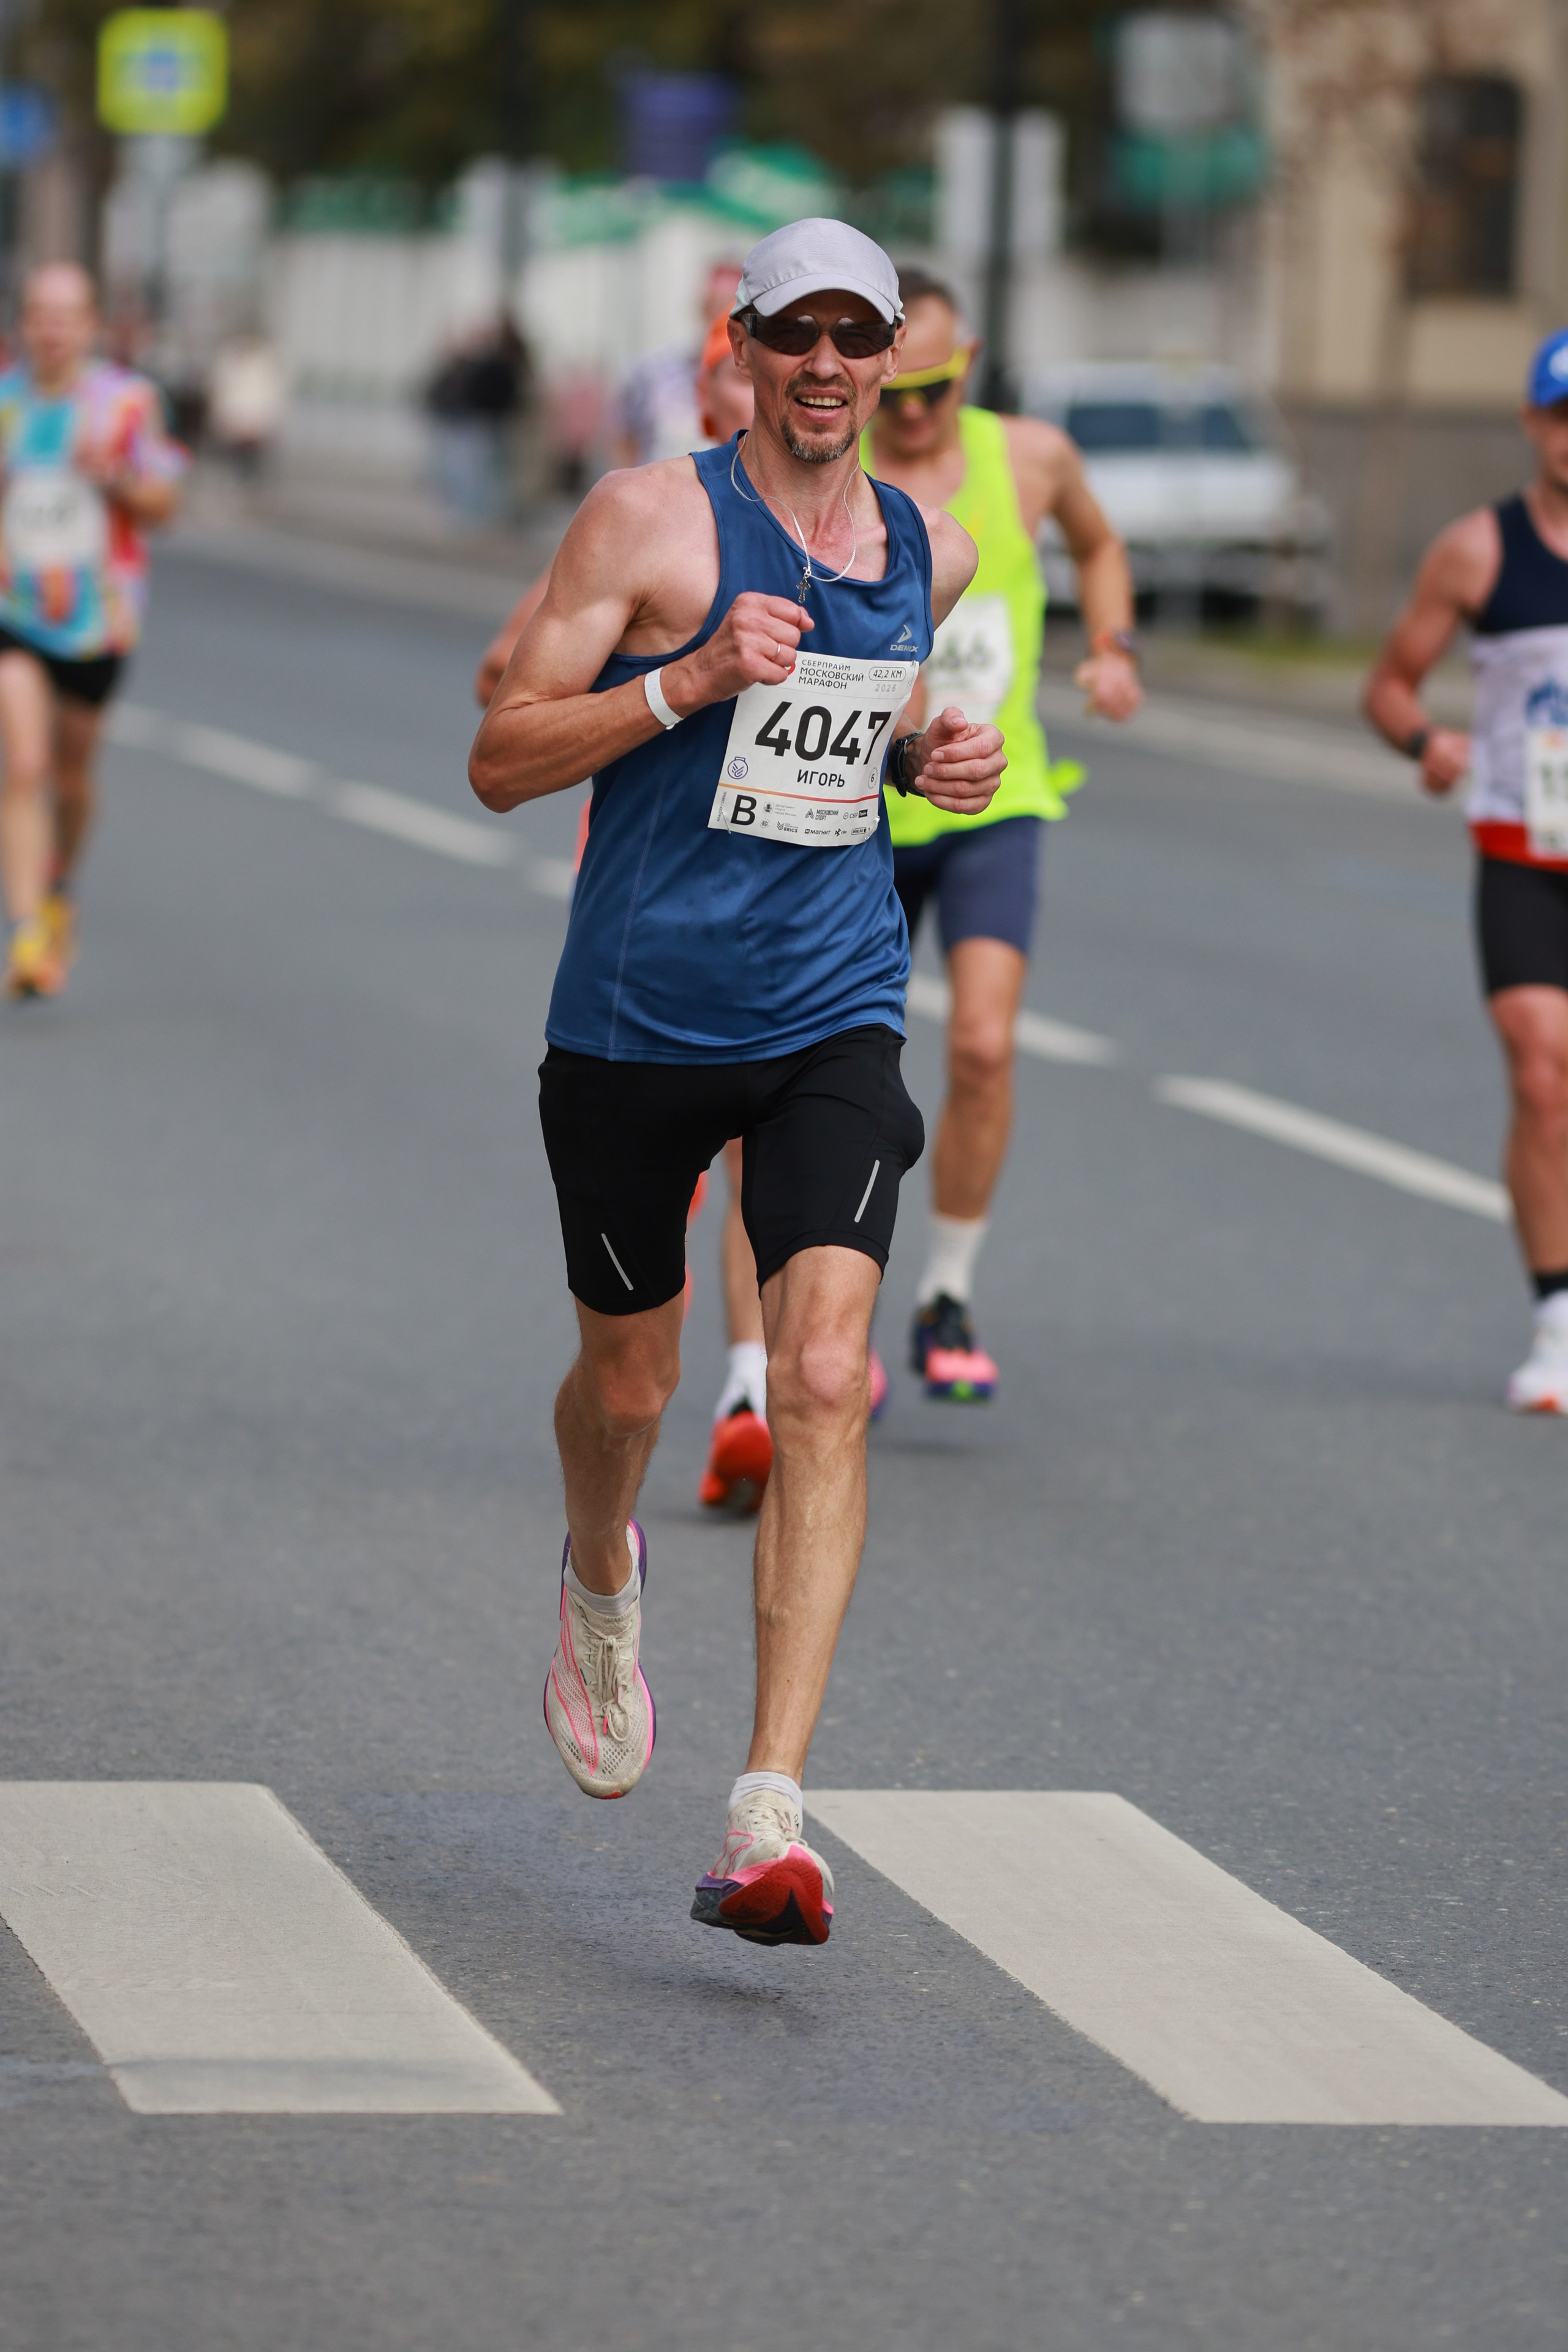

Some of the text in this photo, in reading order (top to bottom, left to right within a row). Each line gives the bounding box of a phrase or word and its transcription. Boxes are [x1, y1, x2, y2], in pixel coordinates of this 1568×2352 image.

[802, 659, 851, 671] СБЕРПРАЙМ
[800, 667, 864, 682] МОСКОВСКИЙ
[873, 669, 888, 679] 42,2
[799, 676, 847, 690] МАРАФОН
[875, 684, 897, 692] 2026
[755, 701, 892, 765] 4047
[797, 769, 845, 788] ИГОРЬ
[870, 774, 875, 782] 6
